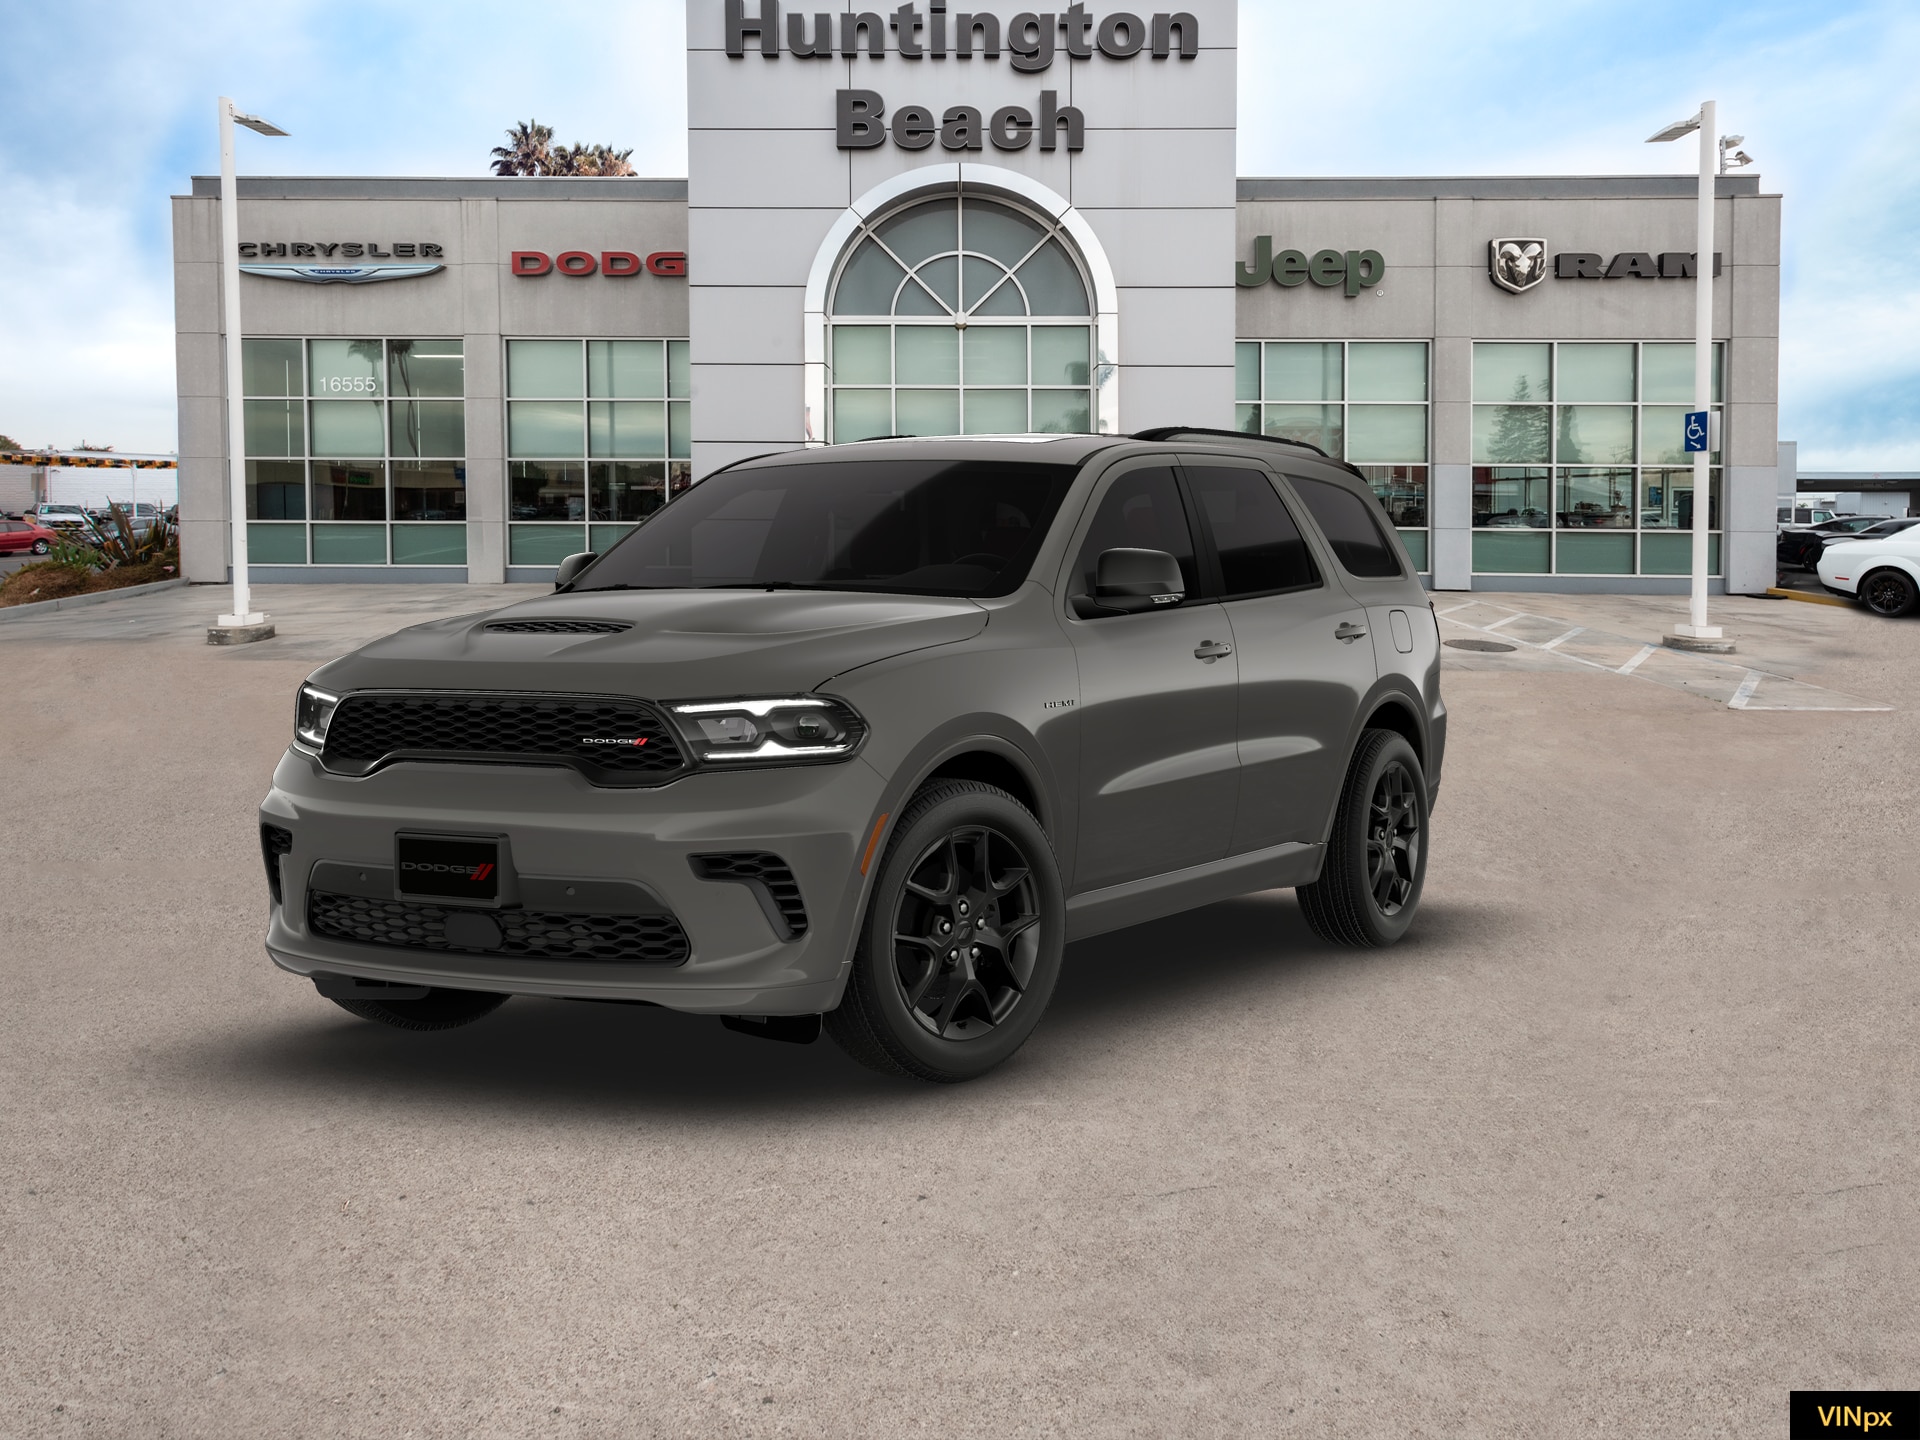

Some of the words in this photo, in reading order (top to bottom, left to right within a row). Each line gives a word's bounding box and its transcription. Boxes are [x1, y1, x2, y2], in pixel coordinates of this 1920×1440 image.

[725, 0, 1199, 73] Huntington
[836, 88, 1085, 152] Beach
[238, 242, 444, 258] CHRYSLER
[1235, 235, 1385, 297] Jeep
[1554, 252, 1722, 279] RAM
[319, 376, 377, 393] 16555
[401, 861, 482, 876] DODGE
